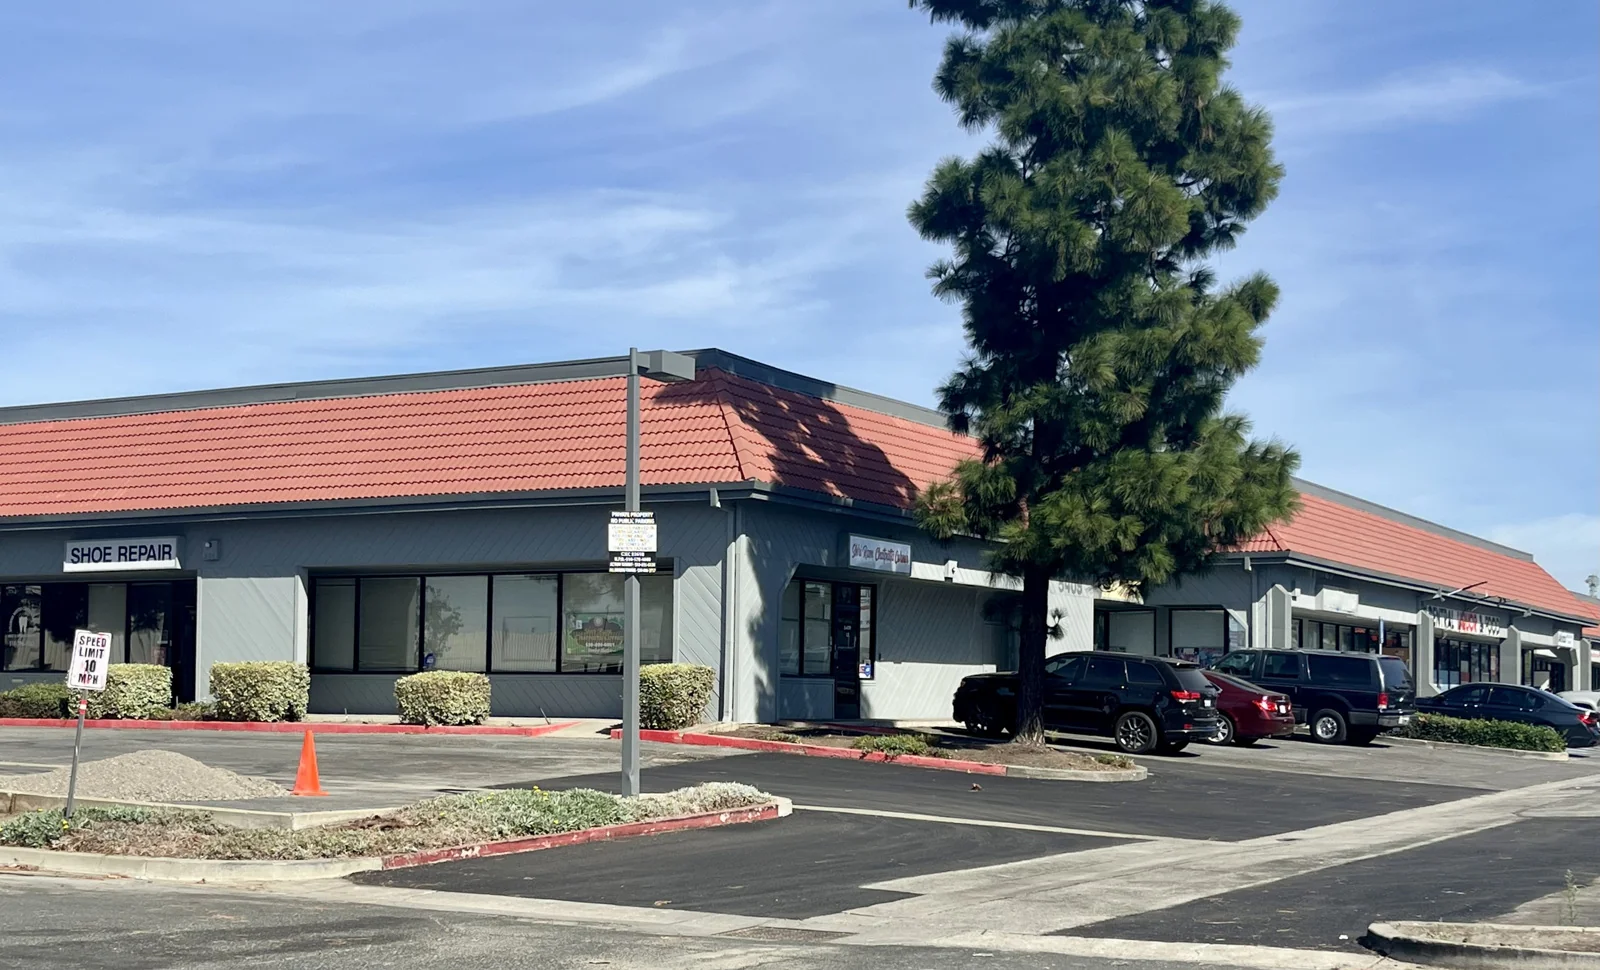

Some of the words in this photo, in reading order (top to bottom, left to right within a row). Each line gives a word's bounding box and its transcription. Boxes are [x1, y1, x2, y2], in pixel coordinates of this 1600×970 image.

[71, 546, 112, 564] SHOE
[118, 543, 172, 562] REPAIR
[78, 635, 107, 648] SPEED
[79, 647, 105, 659] LIMIT
[84, 659, 97, 672] 10
[78, 673, 99, 684] MPH
